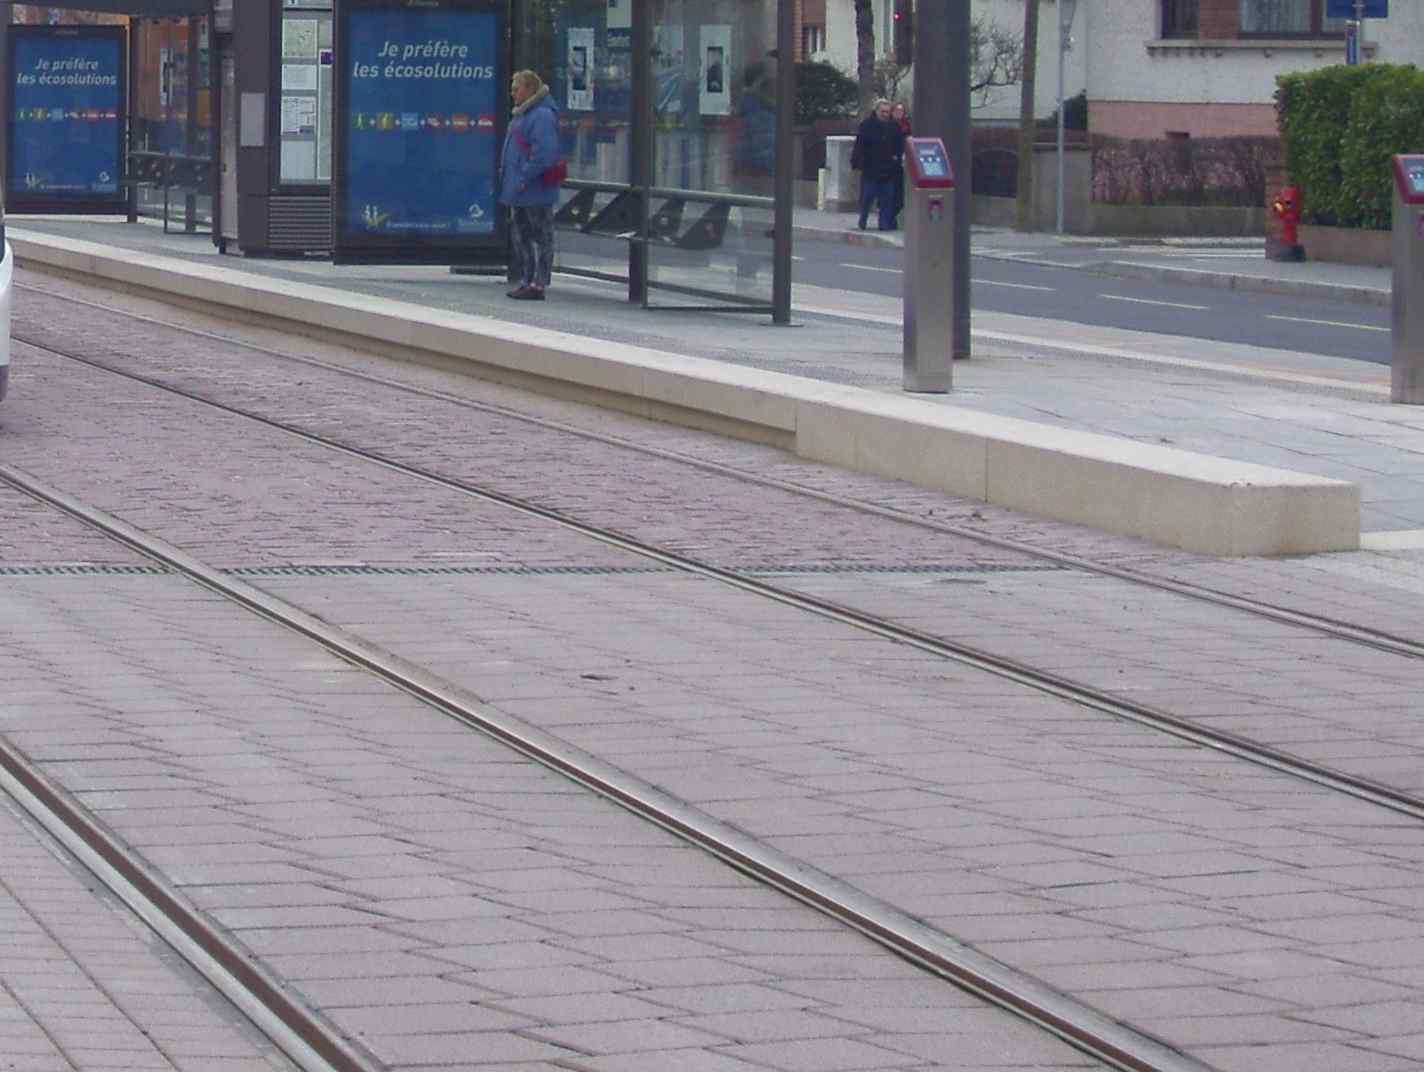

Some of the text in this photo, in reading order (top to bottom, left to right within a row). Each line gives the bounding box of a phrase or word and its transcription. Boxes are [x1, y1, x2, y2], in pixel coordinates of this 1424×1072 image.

[378, 39, 469, 61] Je préfère
[34, 55, 99, 73] Je préfère
[352, 59, 494, 80] les écosolutions
[16, 71, 117, 86] les écosolutions
